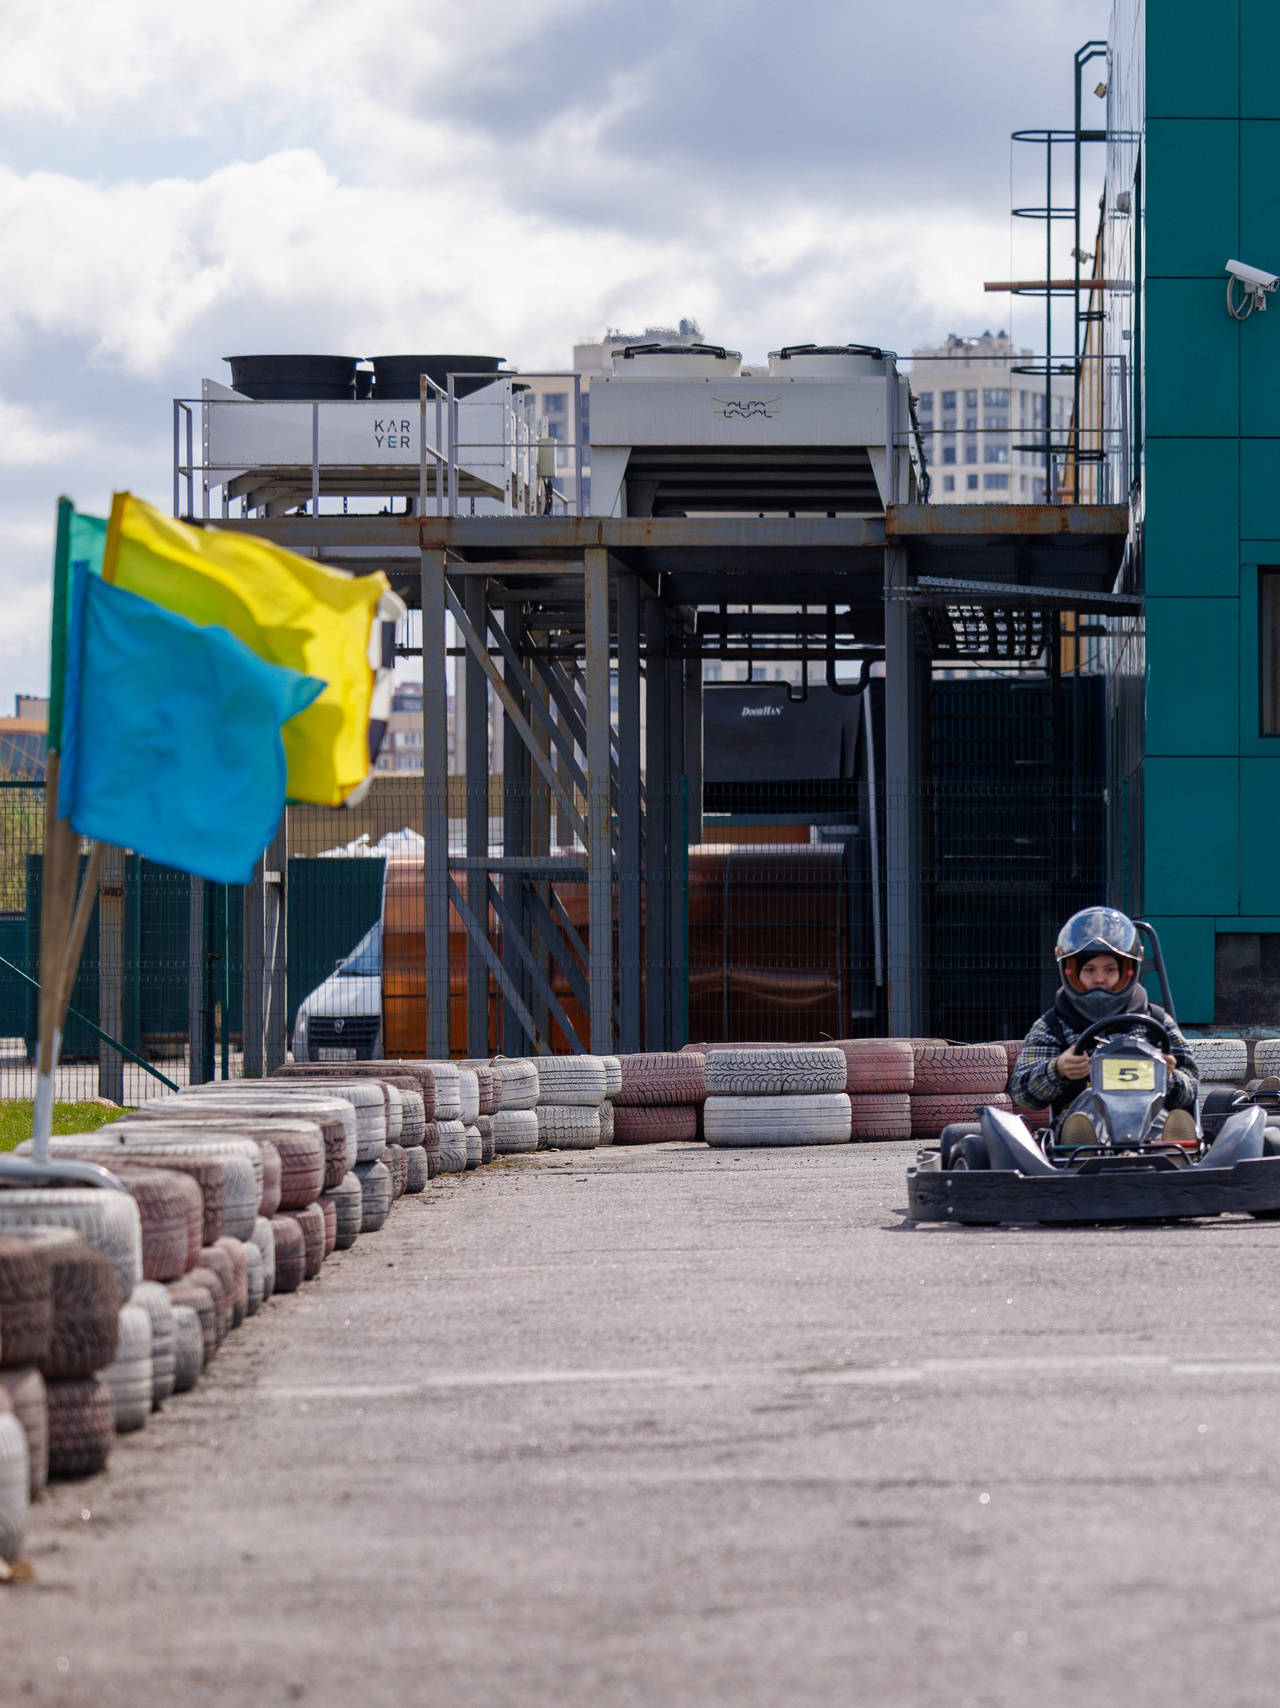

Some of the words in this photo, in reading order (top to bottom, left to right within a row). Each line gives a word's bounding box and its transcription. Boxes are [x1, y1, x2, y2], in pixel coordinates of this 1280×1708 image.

[727, 401, 766, 410] ALFA
[723, 409, 773, 418] LAVAL
[374, 420, 410, 432] KAR
[374, 435, 410, 449] YER
[1118, 1067, 1139, 1082] 5
